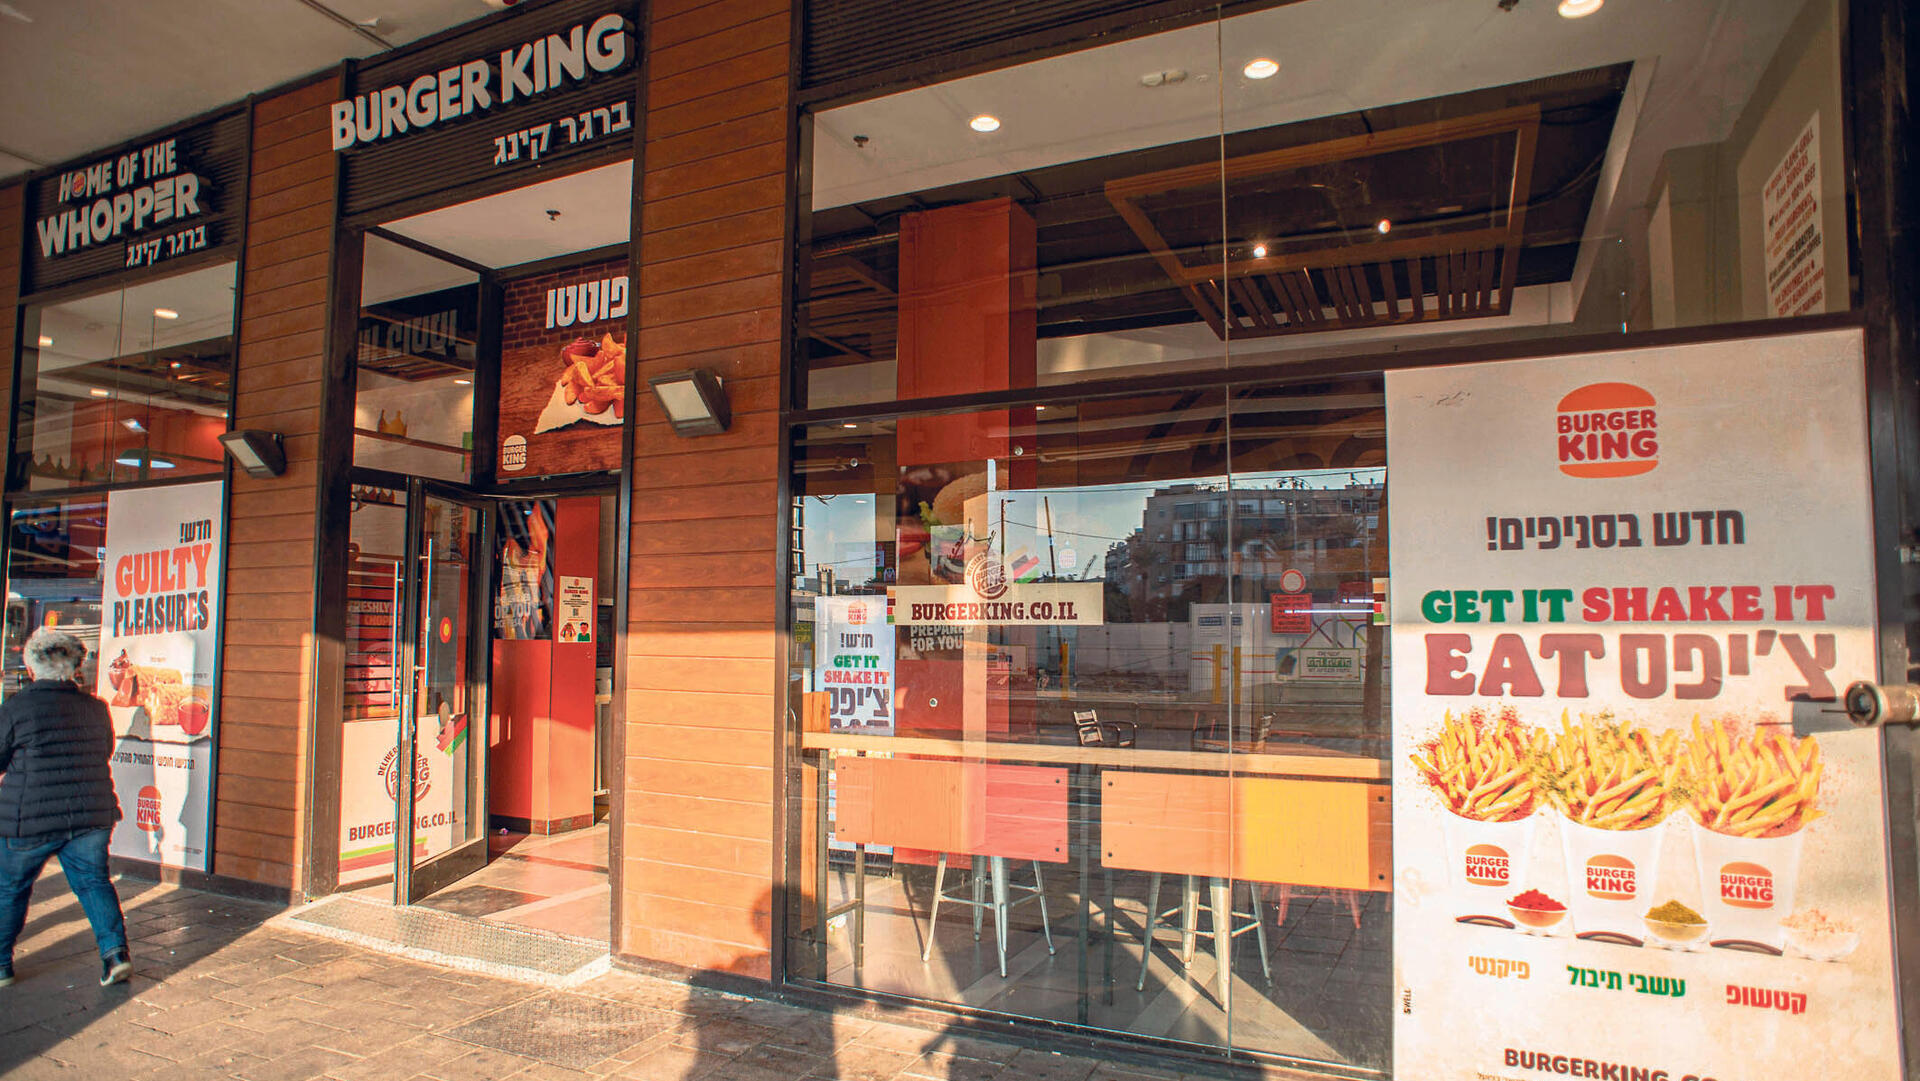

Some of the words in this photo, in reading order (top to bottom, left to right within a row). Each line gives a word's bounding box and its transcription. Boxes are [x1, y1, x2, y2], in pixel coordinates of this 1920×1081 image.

[331, 59, 491, 151] BURGER
[501, 13, 626, 104] KING
[559, 101, 631, 144] ברגר
[494, 123, 551, 166] קינג
[58, 161, 112, 203] HOME
[117, 152, 139, 187] OF
[143, 138, 176, 179] THE
[37, 172, 200, 258] WHOPPER
[126, 238, 162, 268] קינג
[166, 225, 207, 256] ברגר
[546, 276, 630, 329] פוטטו
[1557, 409, 1657, 434] BURGER
[503, 453, 526, 465] KING
[1558, 430, 1659, 462] KING
[180, 519, 212, 544] חדש!
[1486, 513, 1643, 551] בסניפים!
[1653, 510, 1746, 546] חדש
[115, 543, 212, 598] GUILTY
[113, 590, 209, 638] PLEASURES
[911, 602, 1078, 621] BURGERKING.CO.IL
[1421, 589, 1514, 624] GET
[1523, 589, 1573, 623] IT
[1582, 586, 1764, 623] SHAKE
[1773, 584, 1836, 622] IT
[911, 637, 935, 652] FOR
[937, 635, 964, 650] YOU
[833, 654, 861, 668] GET
[864, 655, 880, 669] IT
[1424, 633, 1606, 698] EAT
[824, 670, 872, 684] SHAKE
[874, 671, 890, 685] IT
[137, 798, 161, 810] BURGER
[137, 808, 161, 824] KING
[1466, 856, 1509, 867] BURGER
[1466, 865, 1509, 879] KING
[1586, 867, 1636, 880] BURGER
[1587, 877, 1636, 893] KING
[1720, 874, 1773, 888] BURGER
[1721, 884, 1774, 901] KING
[1468, 955, 1530, 980] פיקנטי
[1566, 964, 1622, 991] תיבול
[1628, 973, 1686, 998] עשבי
[1725, 984, 1807, 1015] קטשופ
